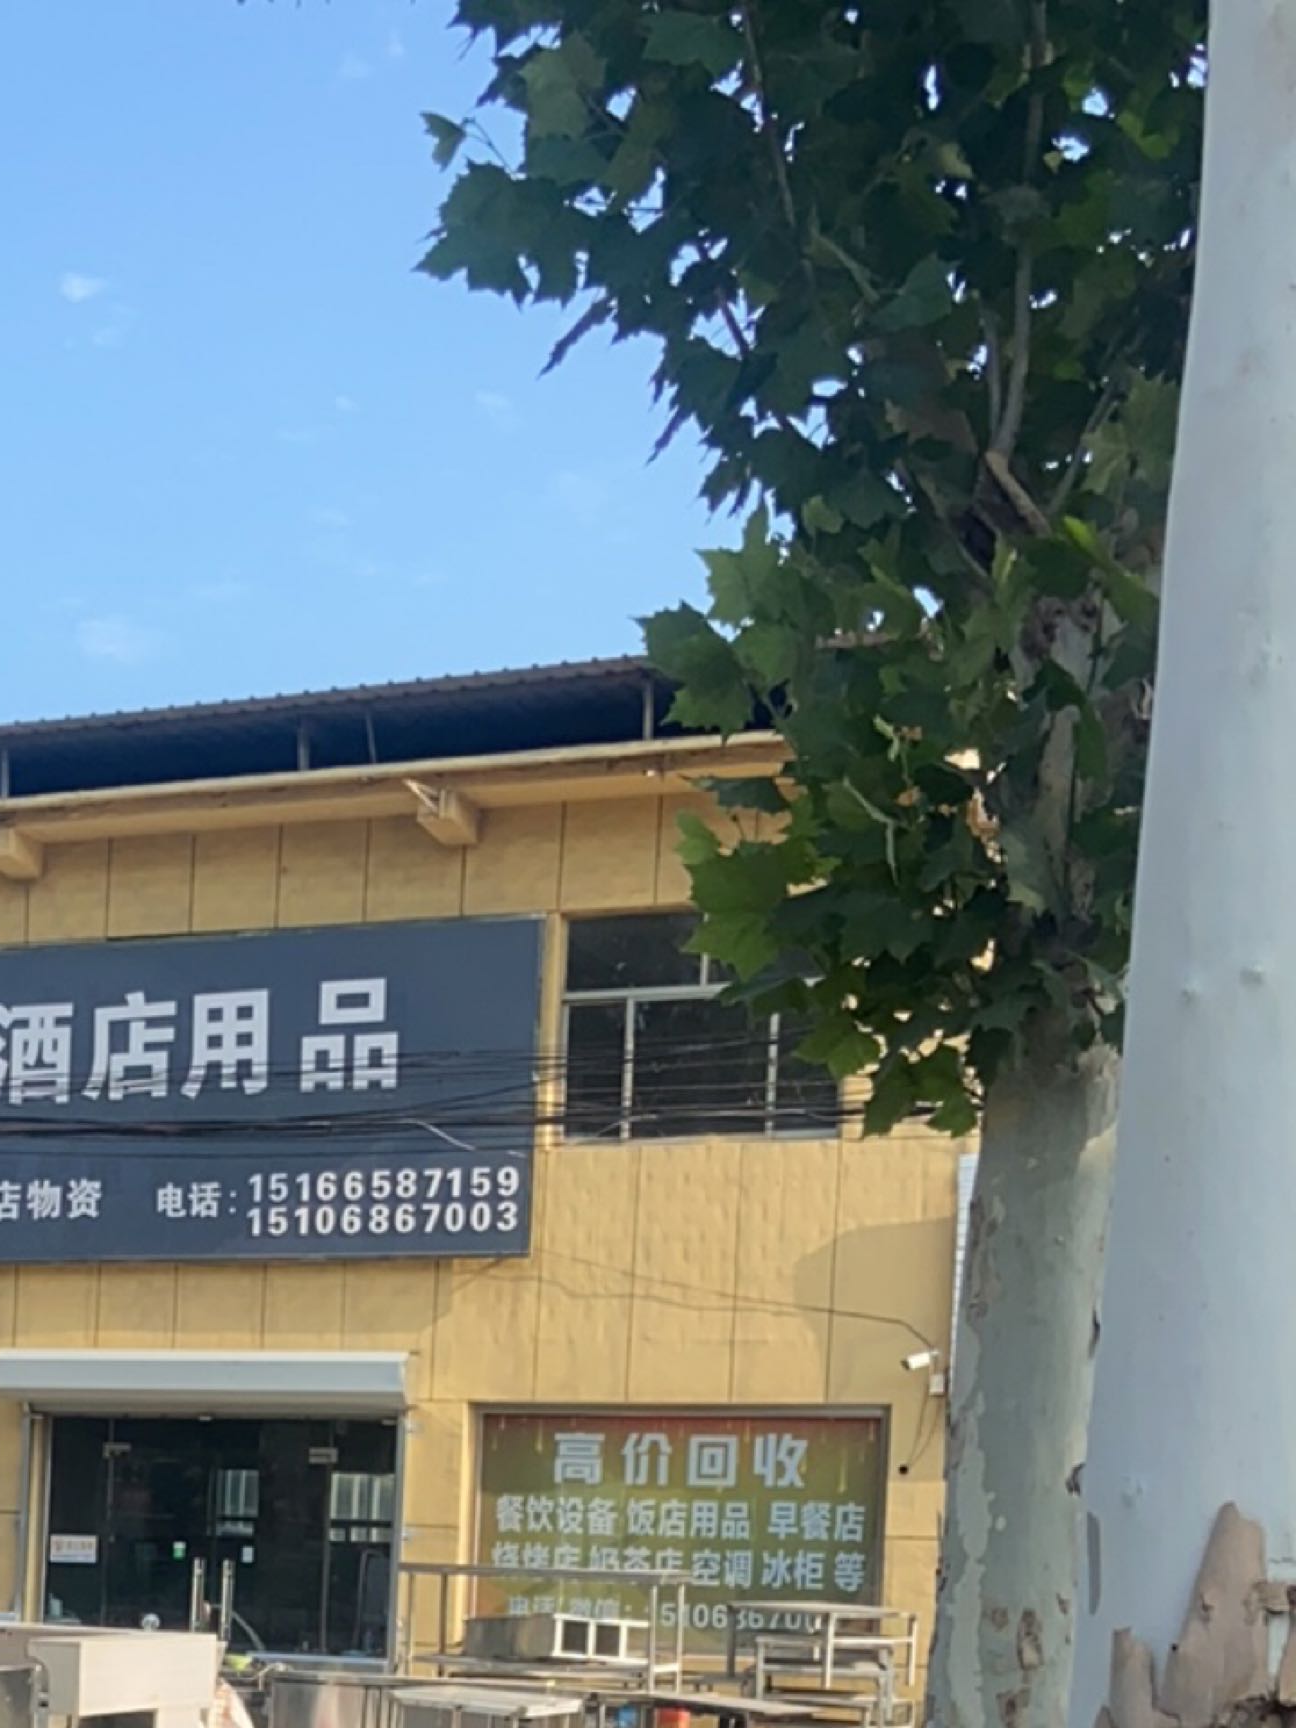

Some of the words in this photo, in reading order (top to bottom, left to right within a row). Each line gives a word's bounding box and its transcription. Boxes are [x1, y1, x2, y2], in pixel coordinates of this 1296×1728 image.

[248, 1167, 519, 1202] 15166587159
[246, 1202, 519, 1236] 15106867003
[553, 1433, 808, 1487] 高价回收
[496, 1495, 618, 1536] 餐饮设备
[627, 1499, 751, 1539] 饭店用品
[767, 1502, 866, 1542] 早餐店
[692, 1550, 753, 1588] 空调
[762, 1551, 824, 1590] 冰柜
[834, 1552, 865, 1592] 等
